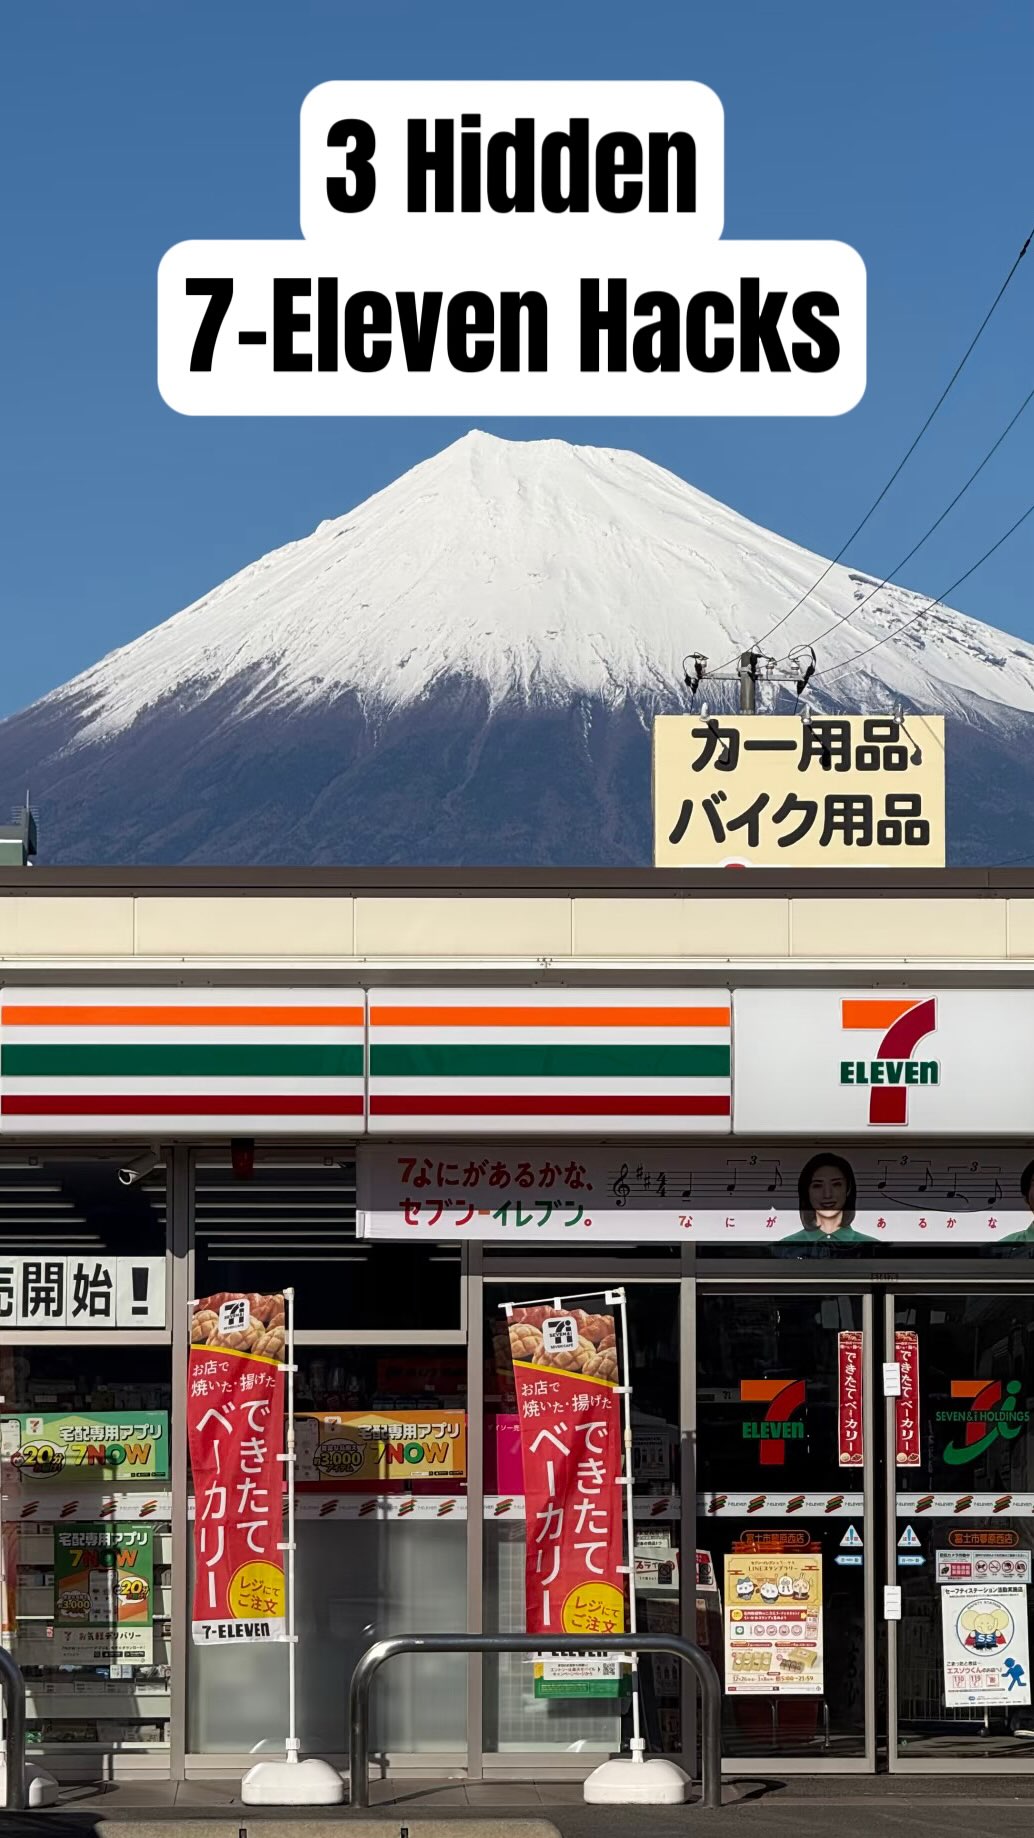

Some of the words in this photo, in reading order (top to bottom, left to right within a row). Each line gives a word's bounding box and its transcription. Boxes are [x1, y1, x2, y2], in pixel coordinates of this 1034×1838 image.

[691, 718, 908, 772] カー用品
[668, 790, 930, 848] バイク用品
[192, 1360, 230, 1377] お店で
[521, 1380, 560, 1396] お店で
[845, 1351, 858, 1452] できたてベーカリー
[900, 1350, 914, 1451] できたてベーカリー
[60, 1423, 163, 1443] 宅配専用アプリ
[358, 1422, 460, 1441] 宅配専用アプリ
[71, 1443, 152, 1466] 7NOW
[371, 1441, 450, 1465] 7NOW
[237, 1399, 271, 1553] できたて
[196, 1402, 235, 1608] ベーカリー
[574, 1421, 609, 1575] できたて
[529, 1421, 571, 1626] ベーカリー
[59, 1531, 149, 1547] 宅配専用アプリ
[240, 1576, 281, 1597] レジにて
[238, 1592, 278, 1615] ご注文
[575, 1595, 620, 1618] レジにて
[571, 1612, 618, 1633] ご注文
